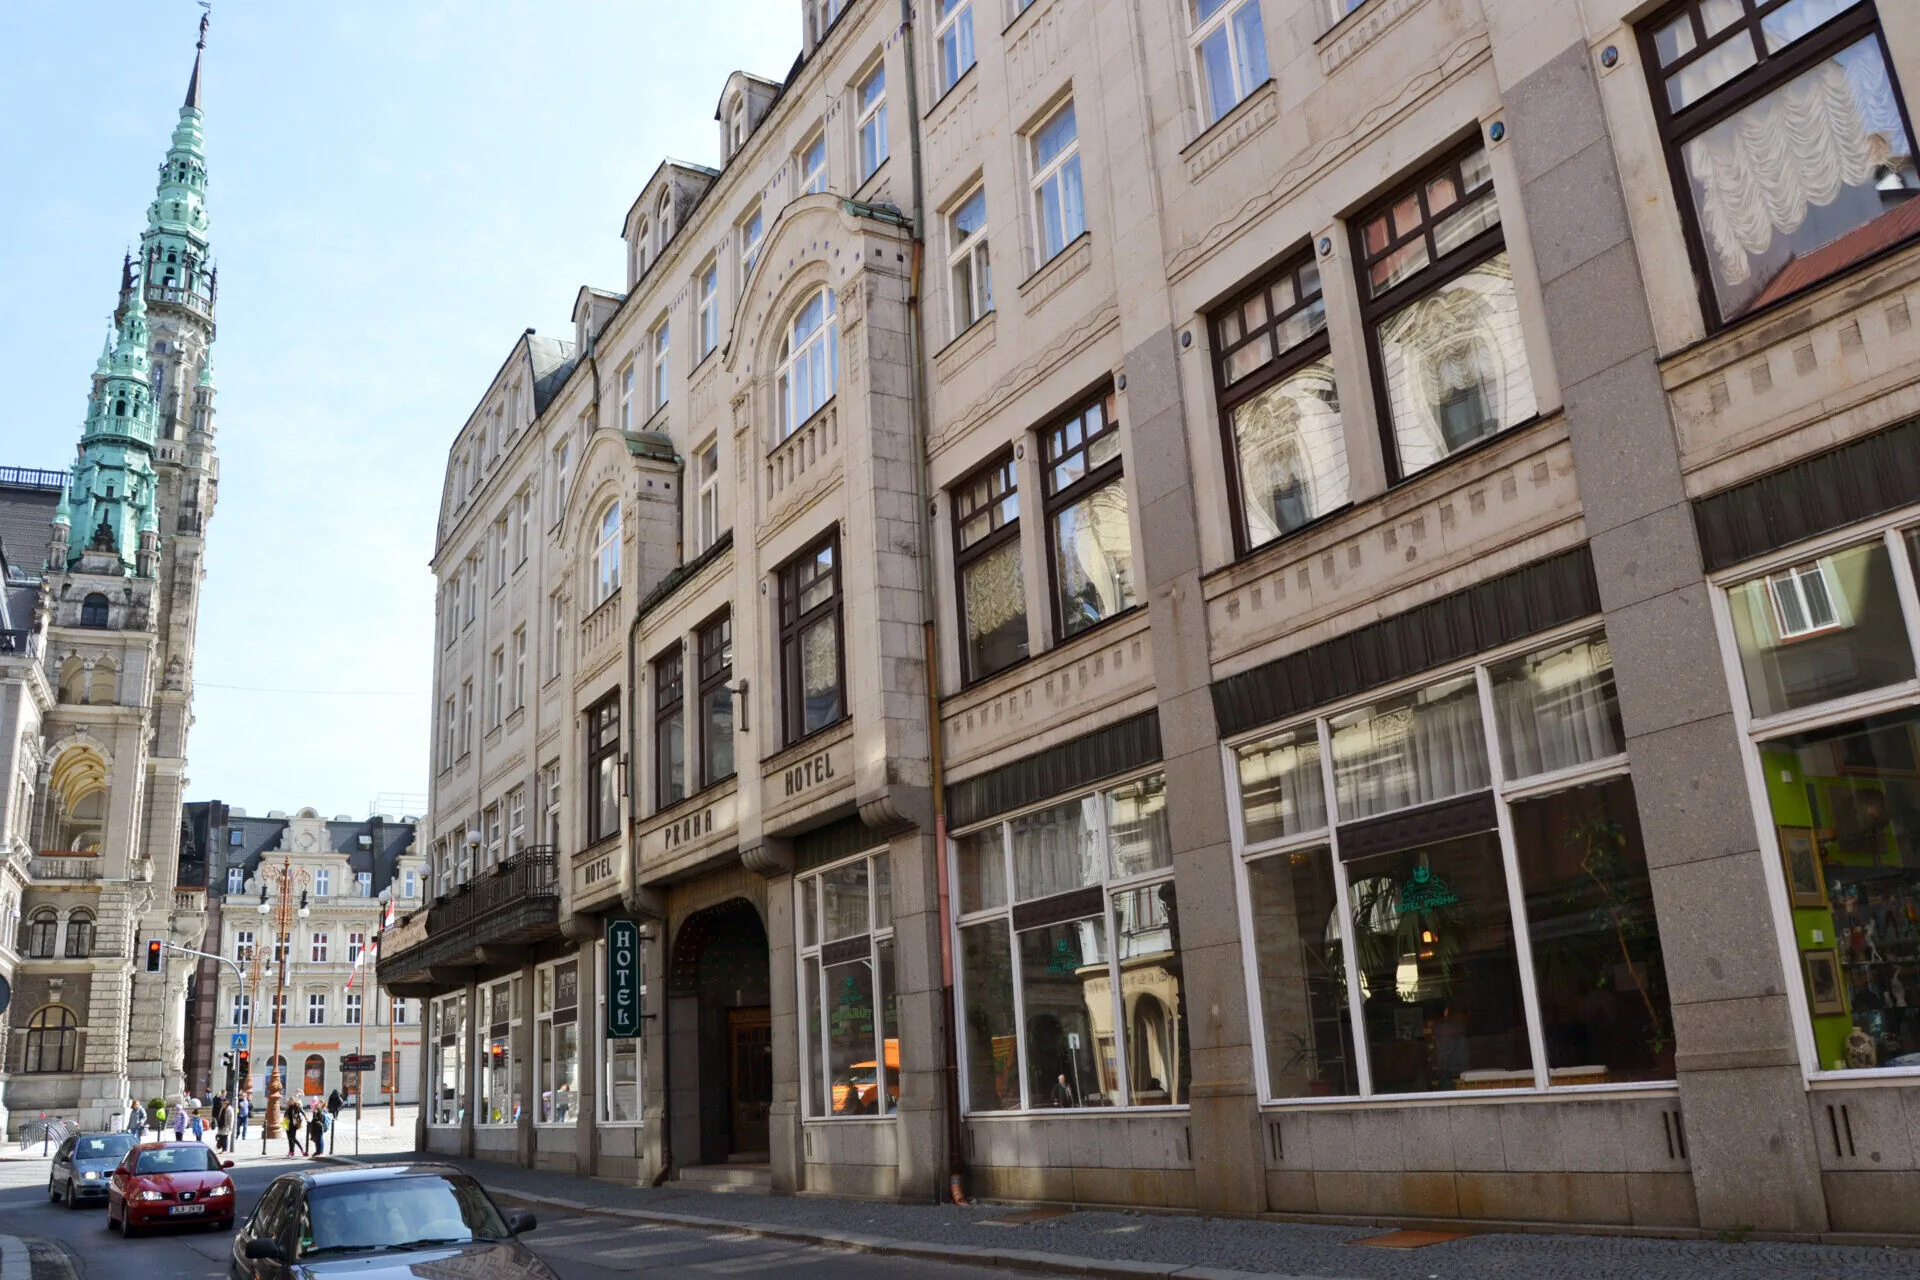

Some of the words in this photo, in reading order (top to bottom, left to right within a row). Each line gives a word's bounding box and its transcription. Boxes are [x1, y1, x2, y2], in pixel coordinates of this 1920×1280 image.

[785, 753, 835, 796] HOTEL
[665, 809, 712, 849] PRAHA
[585, 856, 612, 885] HOTEL
[616, 931, 631, 1025] HOTEL
